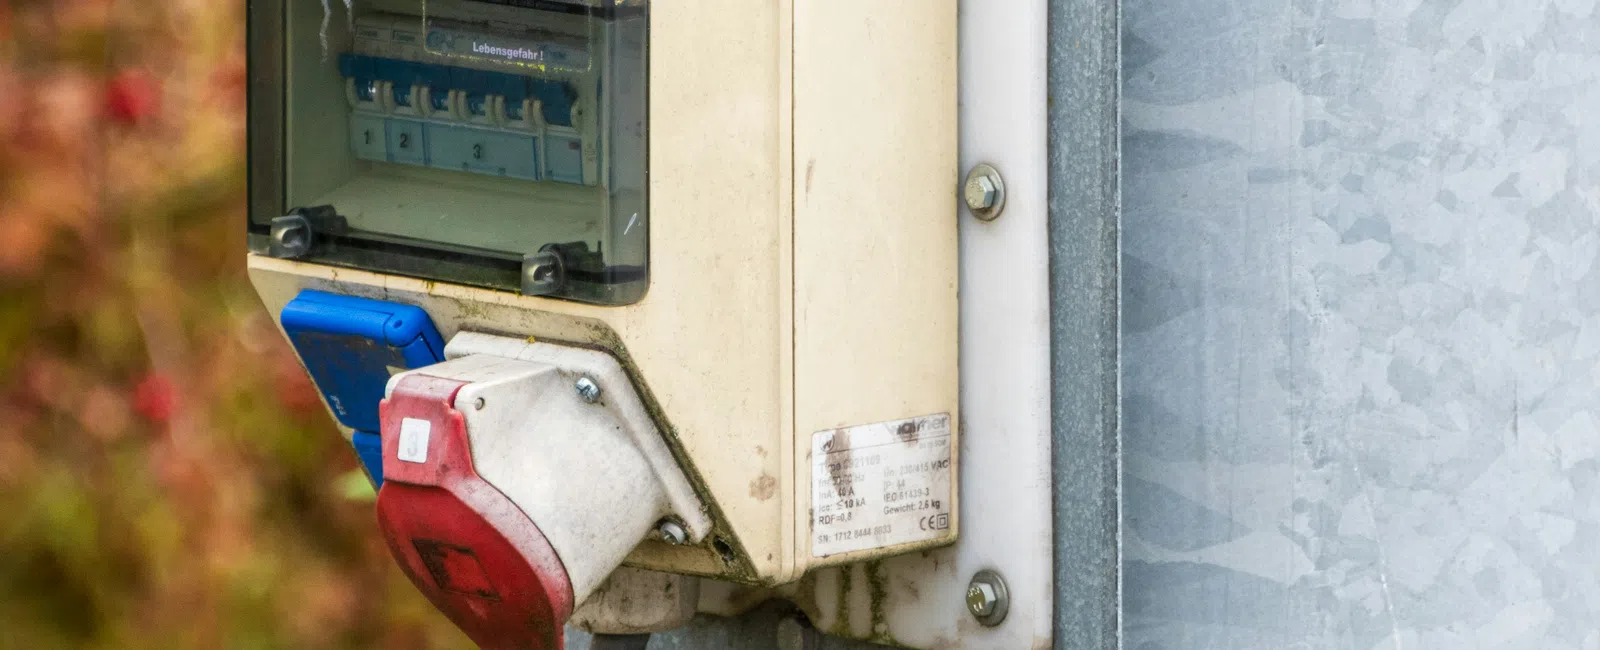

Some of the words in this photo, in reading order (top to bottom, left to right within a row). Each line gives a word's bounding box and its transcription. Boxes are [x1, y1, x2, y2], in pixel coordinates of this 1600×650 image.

[472, 41, 538, 60] Lebensgefahr
[364, 129, 370, 145] 1
[400, 133, 408, 148] 2
[473, 143, 482, 160] 3
[931, 459, 948, 468] VAC
[848, 487, 854, 496] A
[856, 498, 866, 507] kA
[932, 500, 940, 509] kg
[834, 530, 852, 541] 1712
